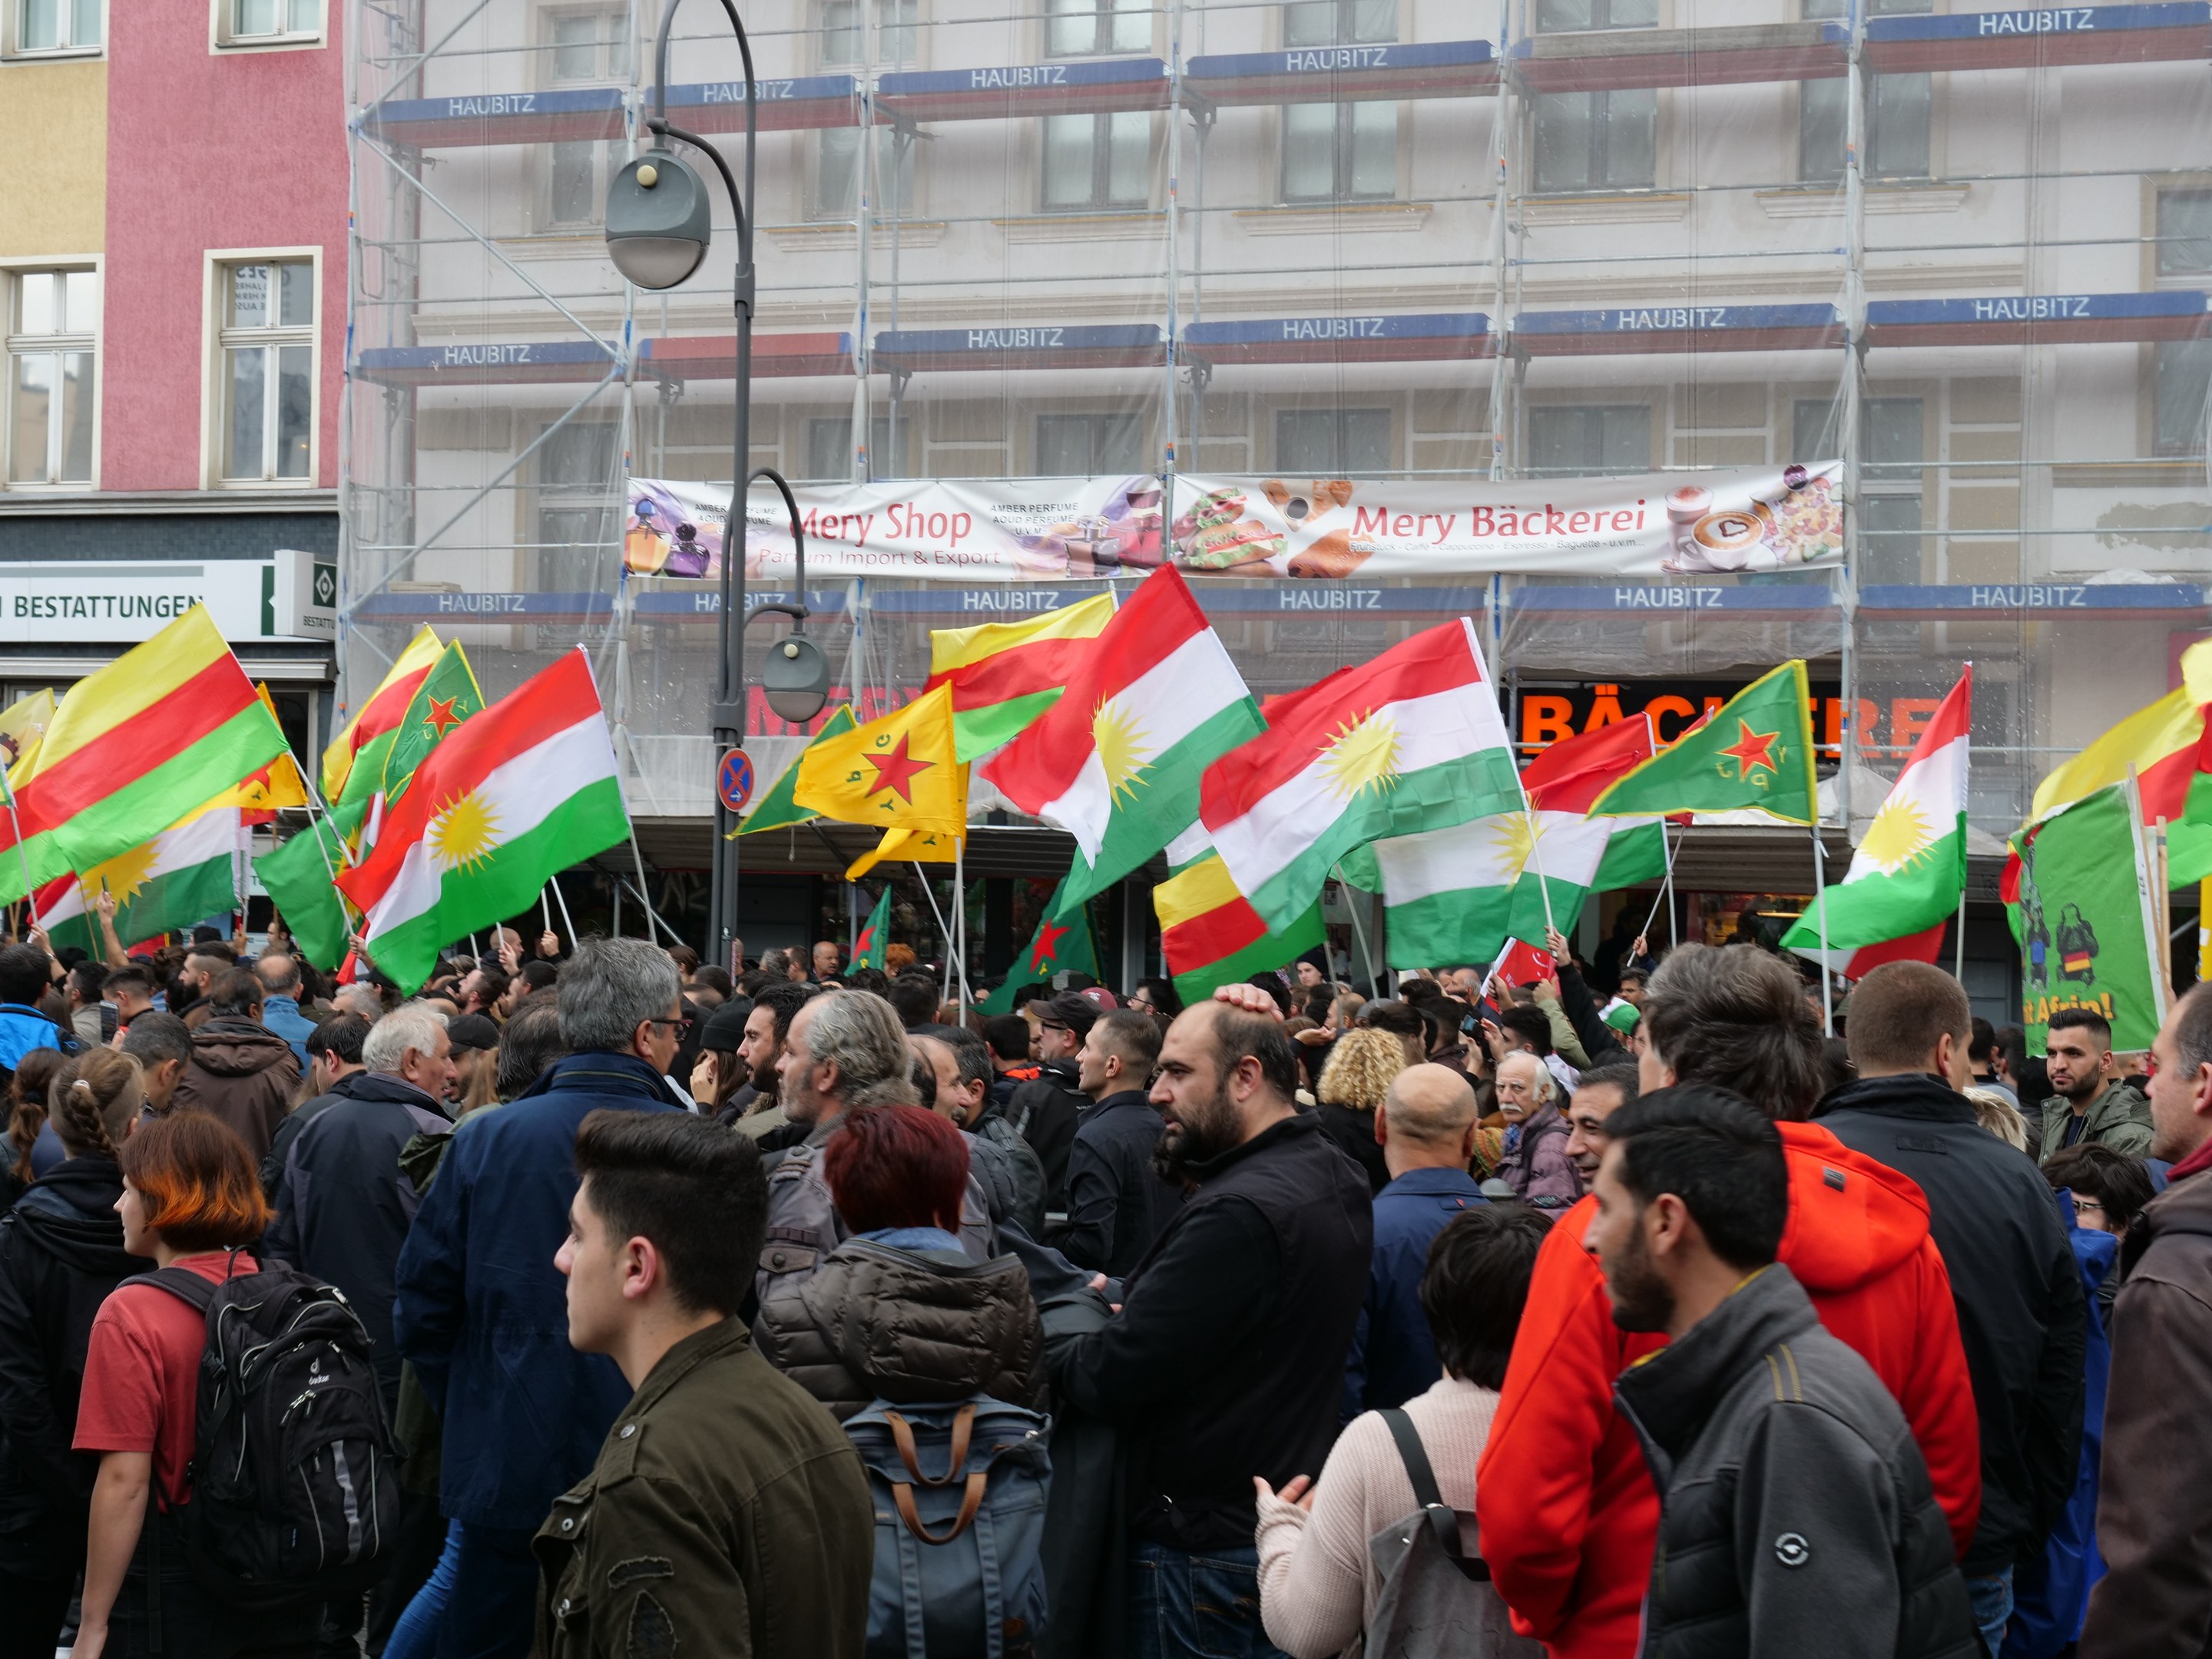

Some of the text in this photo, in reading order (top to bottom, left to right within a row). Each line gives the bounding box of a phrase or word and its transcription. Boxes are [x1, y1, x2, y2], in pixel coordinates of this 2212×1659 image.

[1979, 9, 2094, 35] HAUBITZ
[1286, 48, 1387, 71] HAUBITZ
[972, 67, 1067, 88] HAUBITZ
[449, 94, 535, 117] HAUBITZ
[1618, 308, 1727, 330] HAUBITZ
[1975, 297, 2091, 321] HAUBITZ
[968, 327, 1064, 348] HAUBITZ
[1283, 318, 1386, 340] HAUBITZ
[445, 345, 530, 365] HAUBITZ
[991, 502, 1079, 513] AMBER PERFUME
[790, 502, 972, 548] Mery Shop
[1025, 515, 1075, 524] PERFUME
[1353, 499, 1646, 545] Mery Bäckerei
[759, 548, 1001, 568] Parum Import & Export
[439, 594, 525, 613] HAUBITZ
[694, 592, 786, 612] HABITZ
[963, 591, 1059, 610] HAUBITZ
[1280, 589, 1383, 611] HAUBITZ
[1614, 587, 1723, 609] HAUBITZ
[1972, 586, 2087, 608] HAUBITZ
